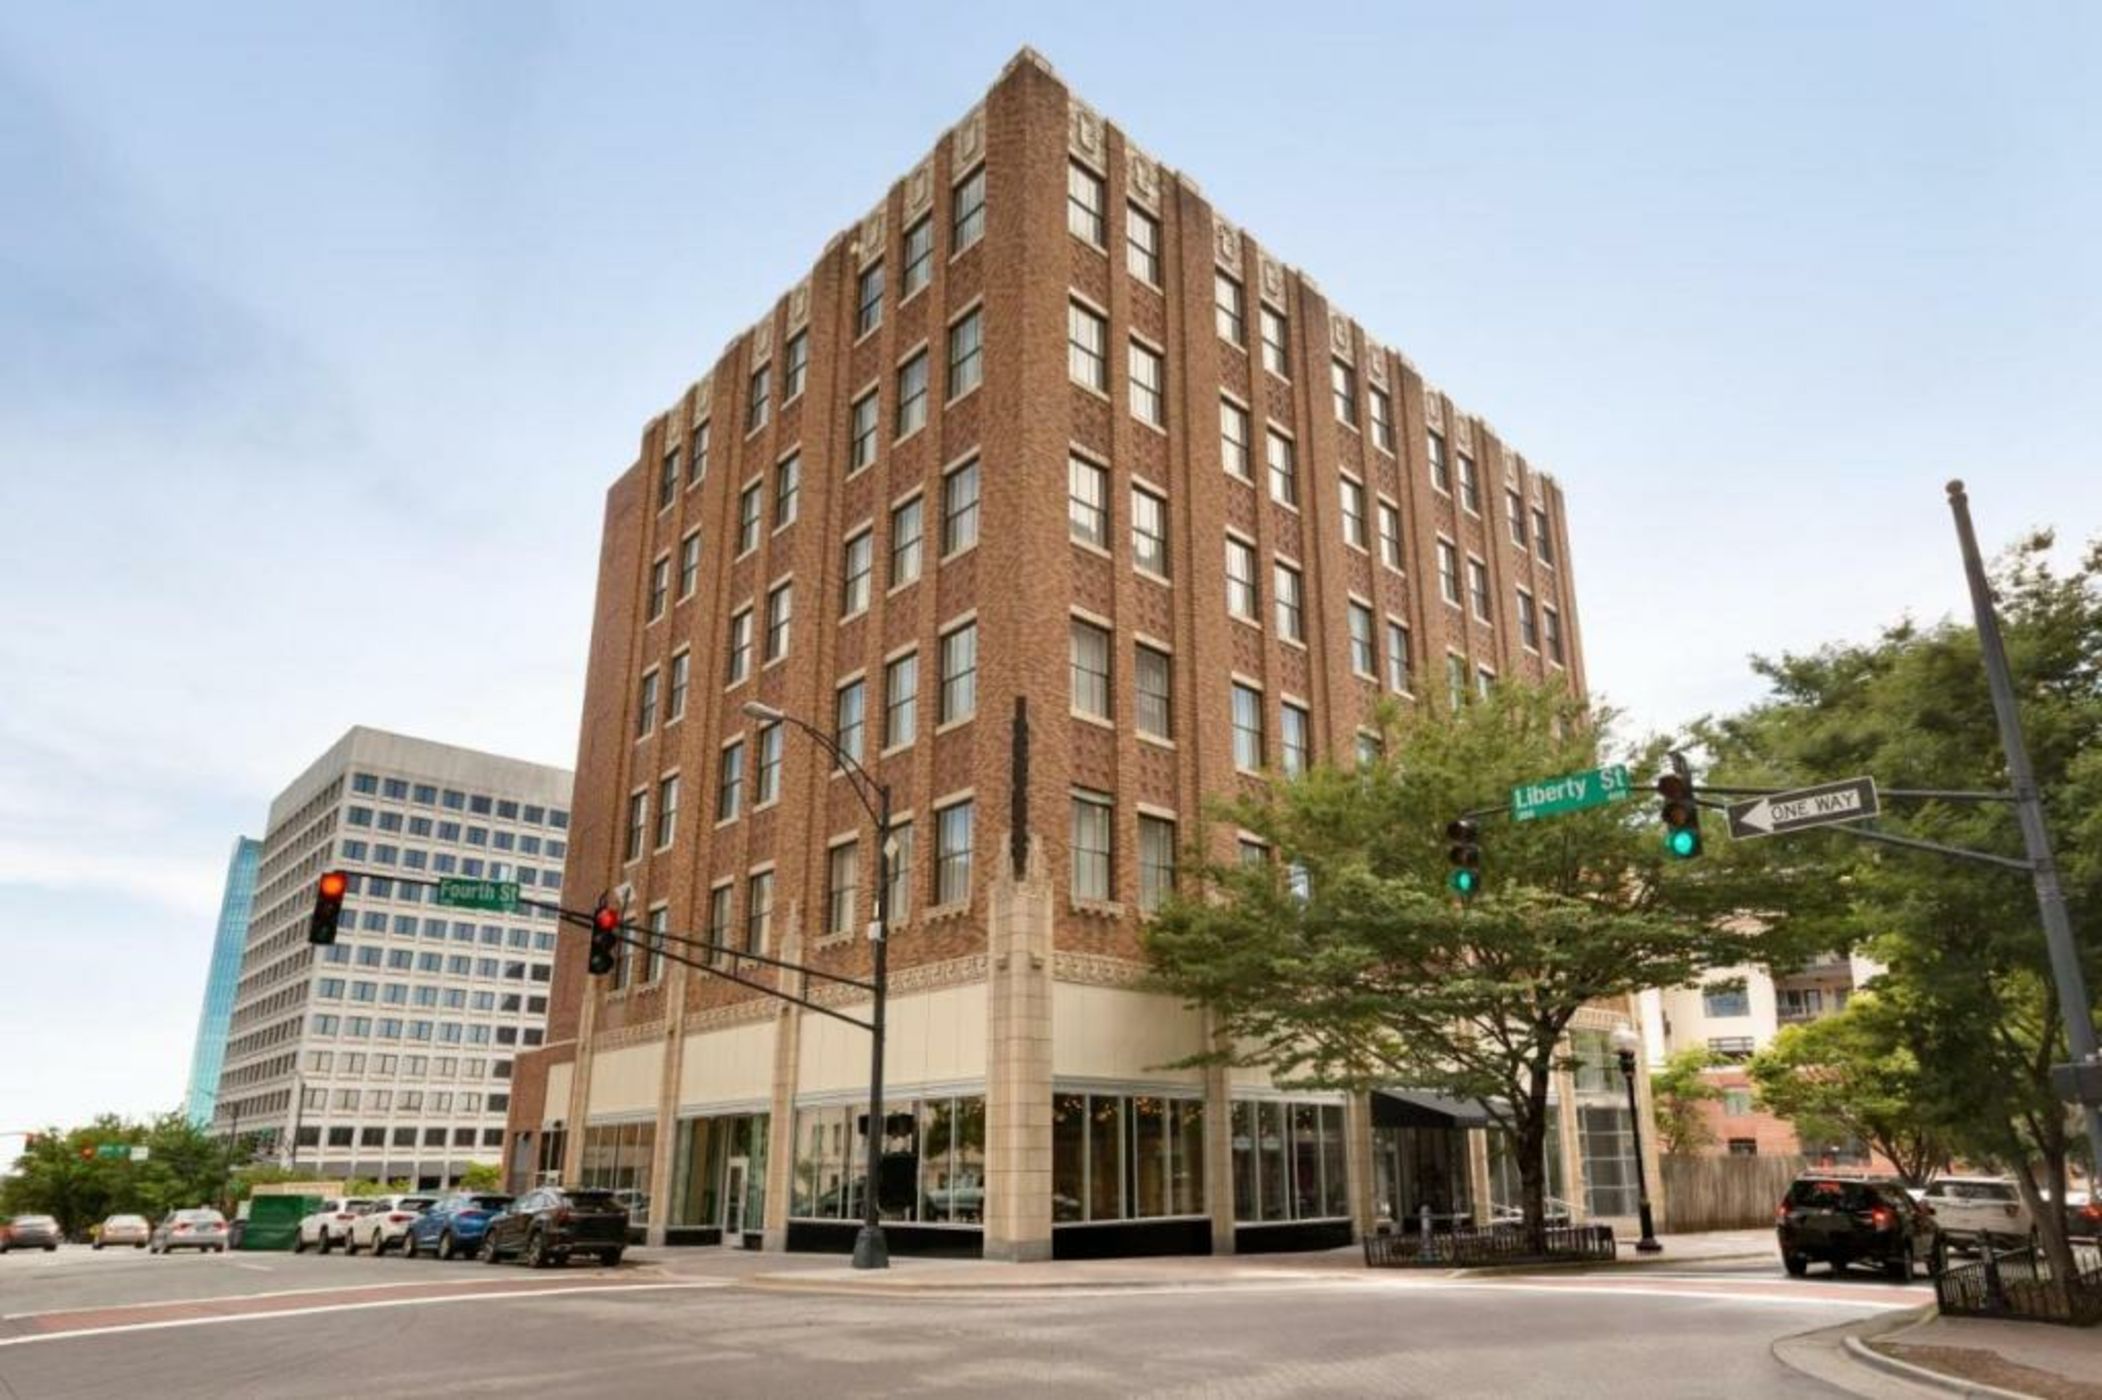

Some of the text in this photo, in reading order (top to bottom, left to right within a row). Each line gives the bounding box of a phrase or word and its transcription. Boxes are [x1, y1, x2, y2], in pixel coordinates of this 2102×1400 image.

[1514, 777, 1586, 809] Liberty
[1600, 767, 1625, 791] St
[1771, 792, 1855, 821] ONE WAY
[441, 880, 518, 902] Fourth St
